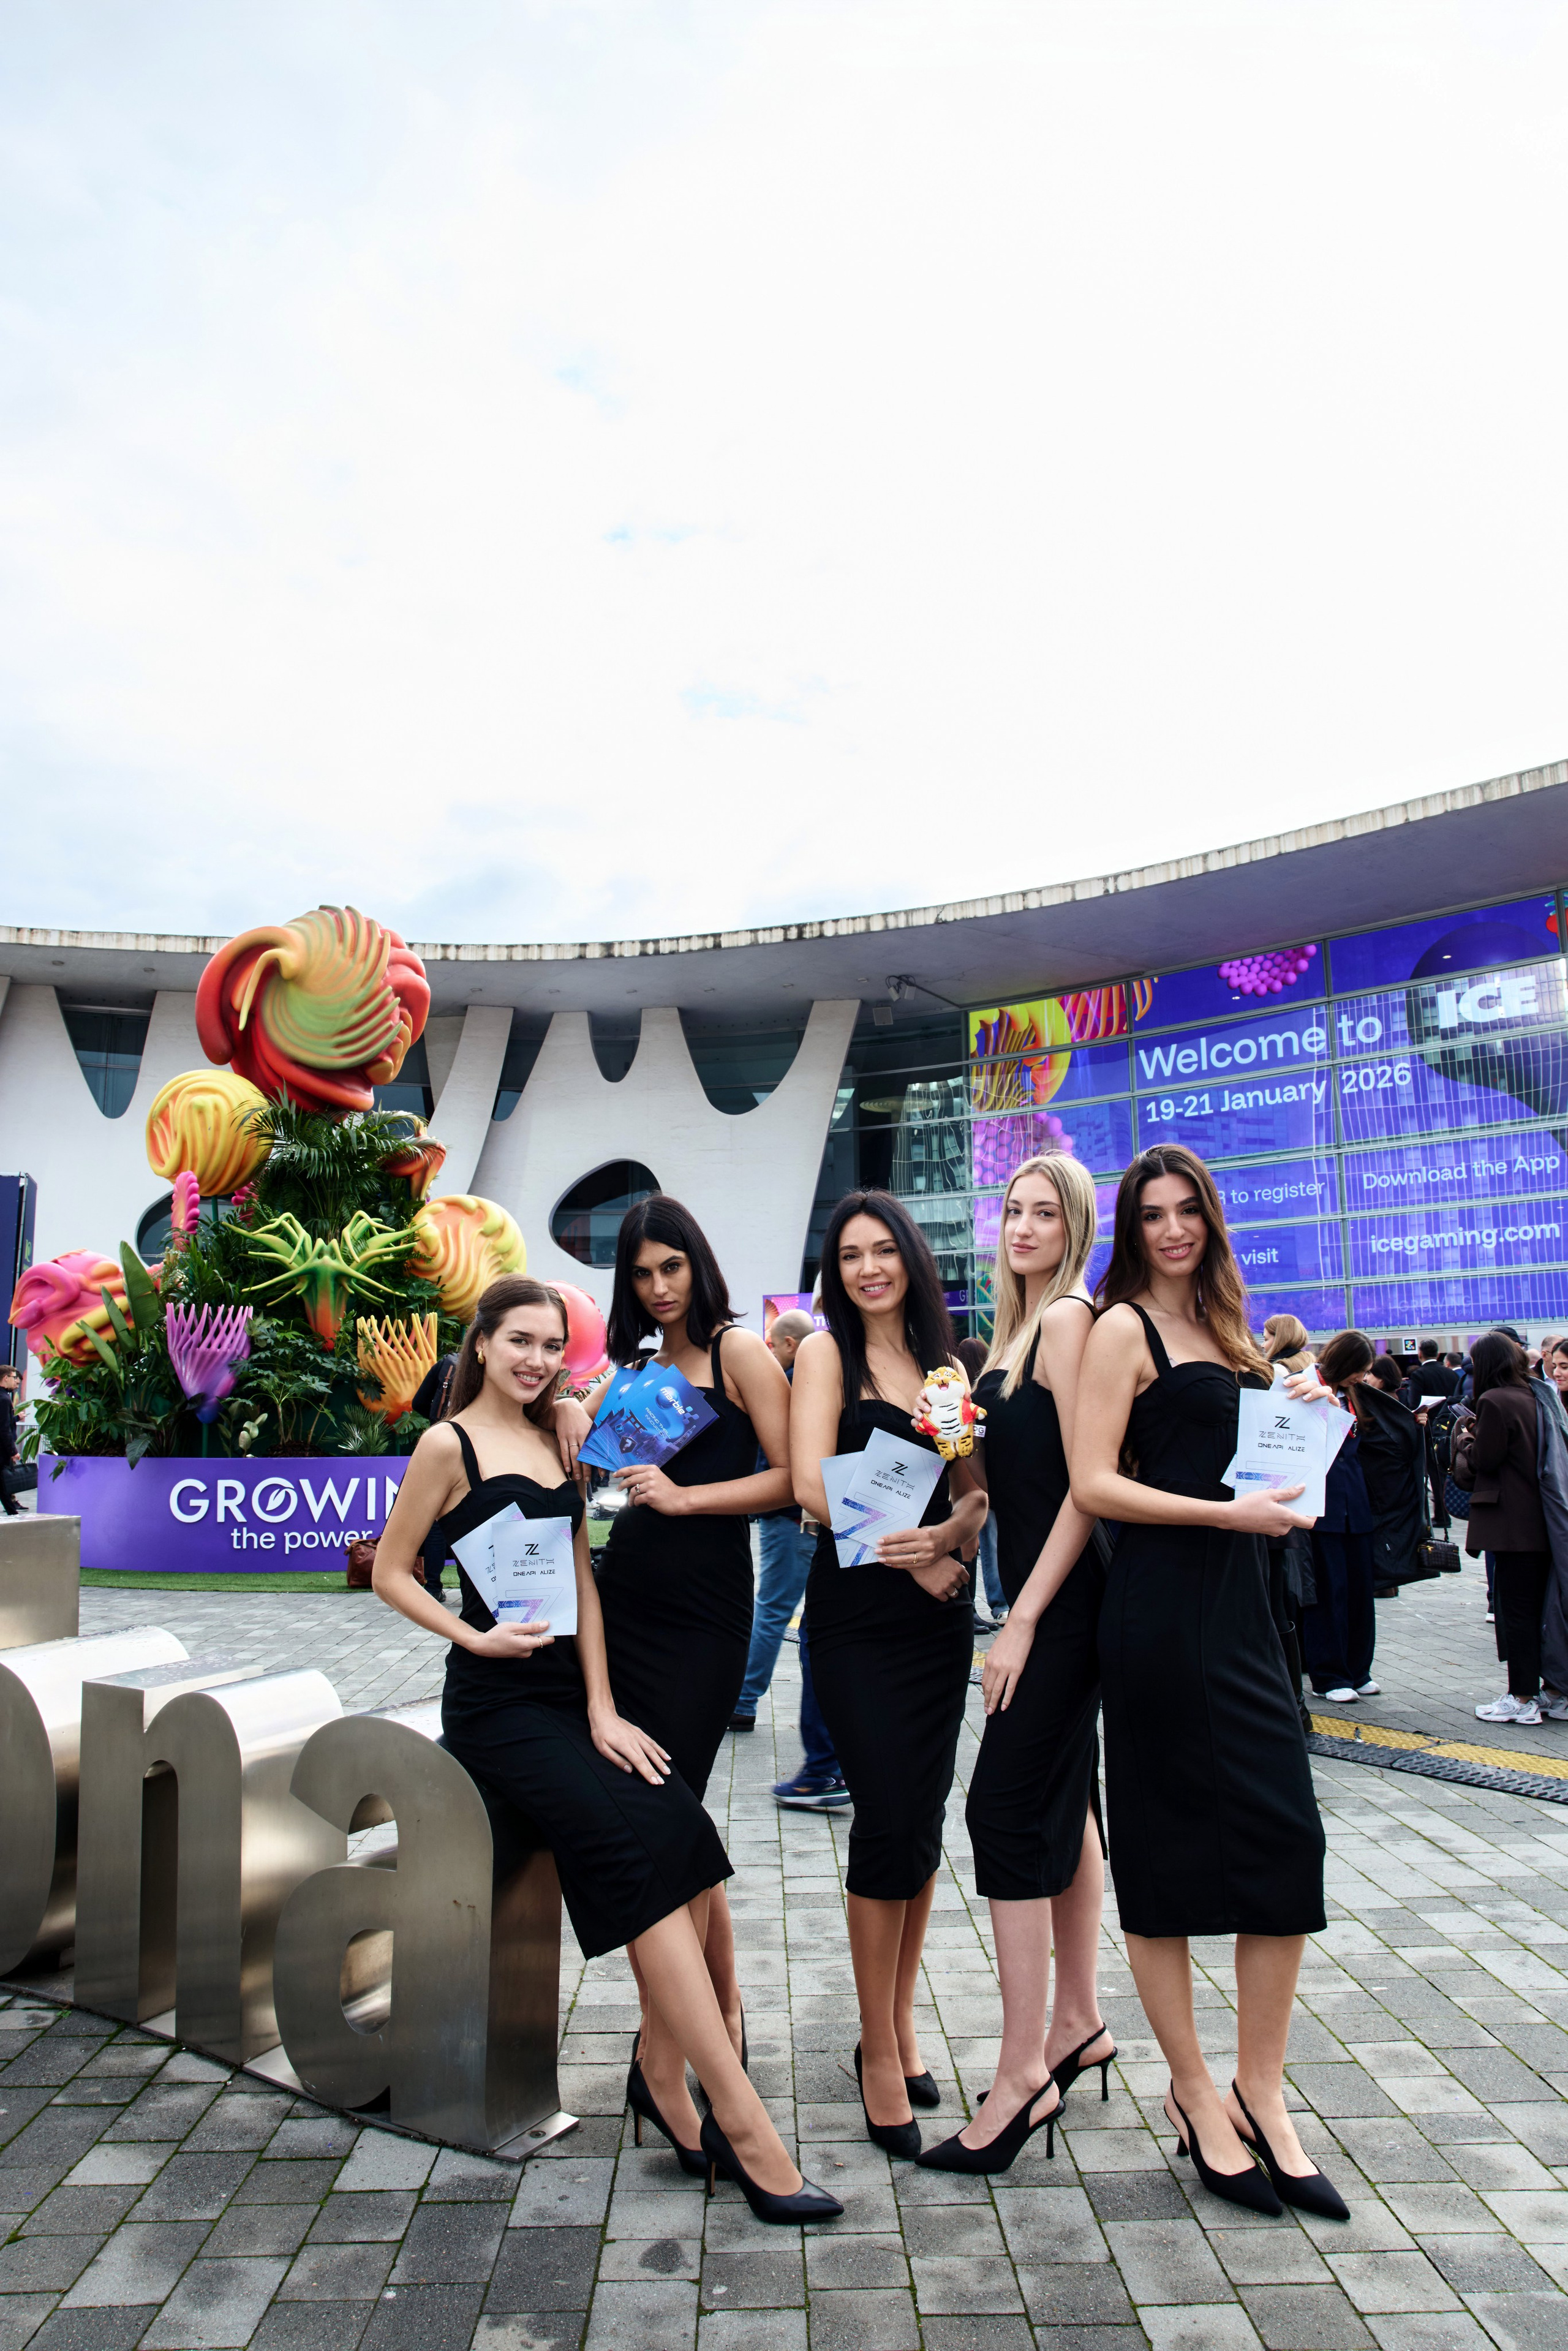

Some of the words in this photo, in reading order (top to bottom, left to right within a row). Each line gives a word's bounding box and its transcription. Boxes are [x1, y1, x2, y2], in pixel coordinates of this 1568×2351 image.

[1437, 975, 1539, 1029] ICE
[1138, 1025, 1326, 1080] Welcome
[1338, 1014, 1382, 1047] to
[1146, 1093, 1214, 1123] 19-21
[1220, 1080, 1327, 1112] January
[1341, 1062, 1411, 1094] 2026
[1362, 1161, 1468, 1190] Download
[1472, 1160, 1508, 1177] the
[1513, 1155, 1560, 1176] App
[1231, 1190, 1249, 1204] to
[1254, 1182, 1325, 1204] register
[1371, 1223, 1561, 1255] icegaming.com
[1241, 1248, 1279, 1266] visit
[660, 1388, 685, 1415] marble
[1259, 1430, 1305, 1441] ZENITH
[874, 1470, 915, 1490] ZENITH
[895, 1490, 911, 1499] ALIZE
[231, 1527, 276, 1550] the
[284, 1530, 373, 1554] power
[512, 1558, 555, 1567] ZENITH
